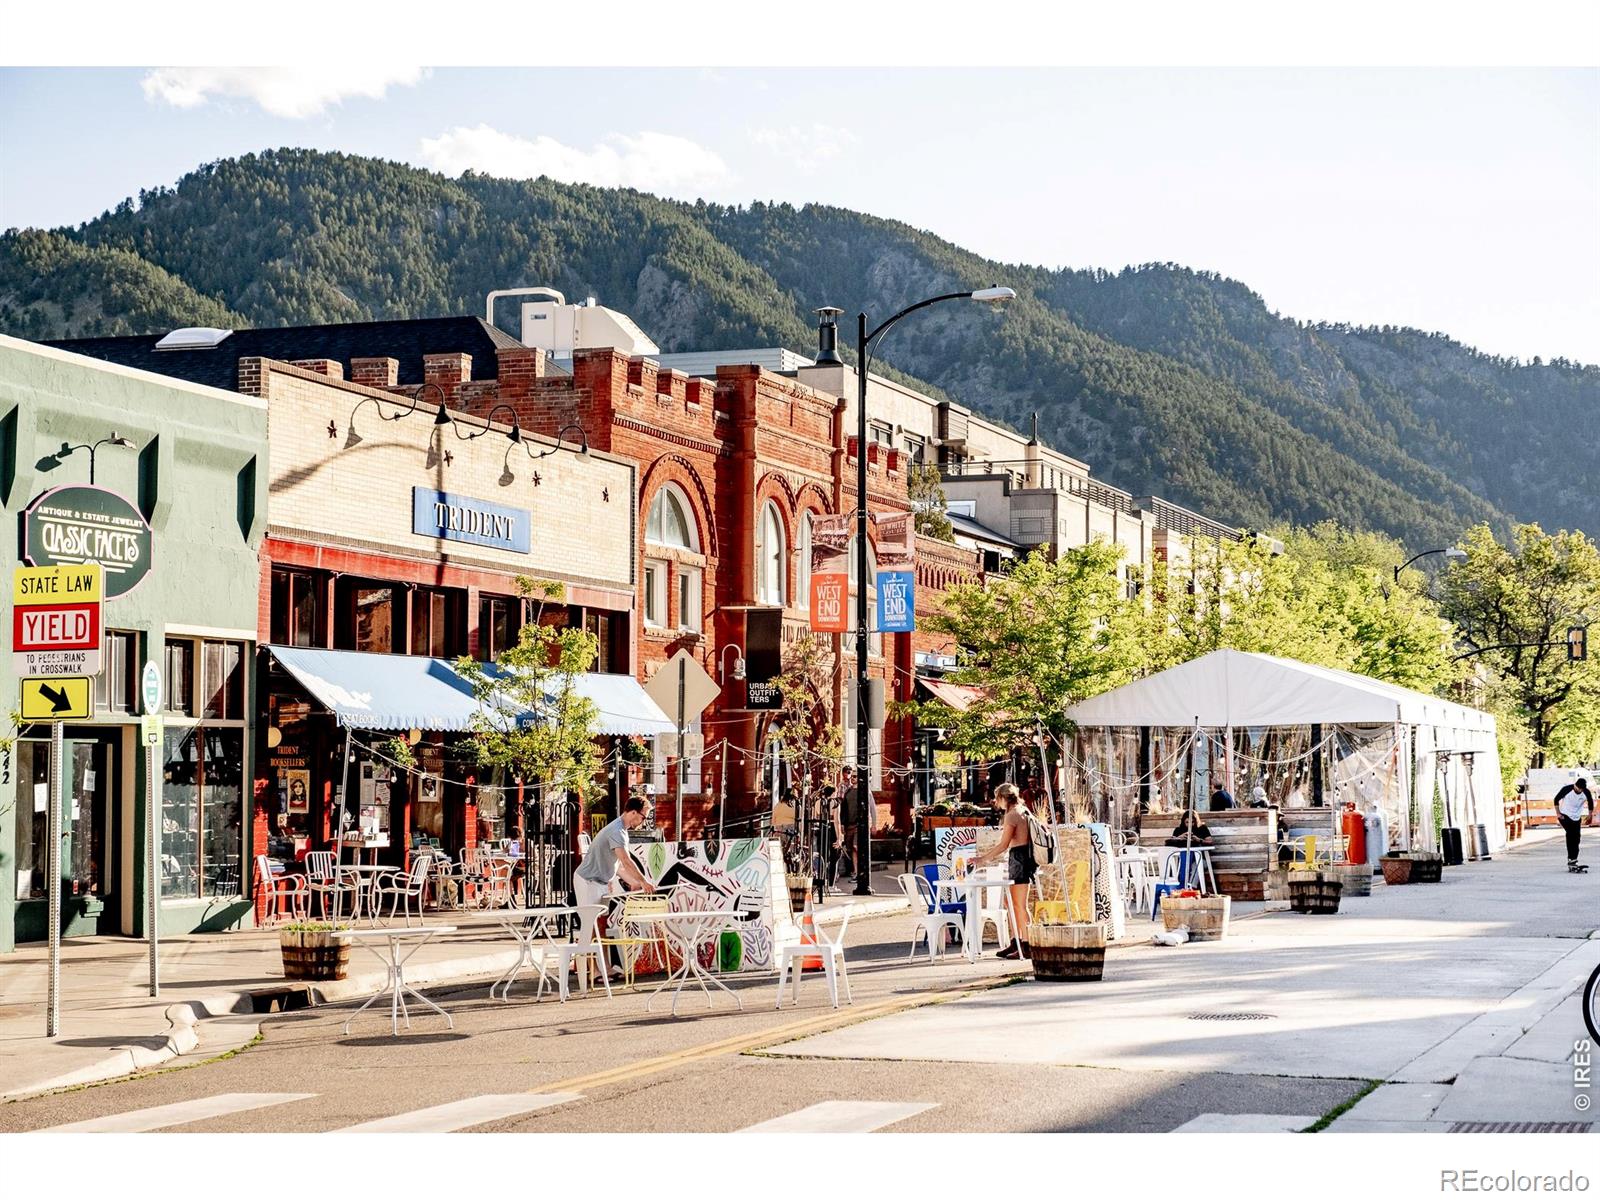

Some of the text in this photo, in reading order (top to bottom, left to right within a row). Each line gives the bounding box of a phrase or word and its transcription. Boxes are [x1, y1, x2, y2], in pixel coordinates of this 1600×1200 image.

[38, 506, 72, 518] ANTIQUE
[82, 512, 110, 523] ESTATE
[111, 516, 143, 528] JEWELRY
[434, 502, 515, 541] TRIDENT
[42, 522, 139, 562] CLASSIC FACETS
[21, 575, 93, 594] STATE LAW
[816, 585, 842, 600] WEST
[882, 583, 908, 598] WEST
[818, 600, 840, 616] END
[884, 598, 906, 614] END
[26, 613, 87, 641] YIELD
[26, 654, 35, 664] TO
[29, 664, 82, 674] IN CROSSWALK
[277, 745, 299, 755] TRIDENT
